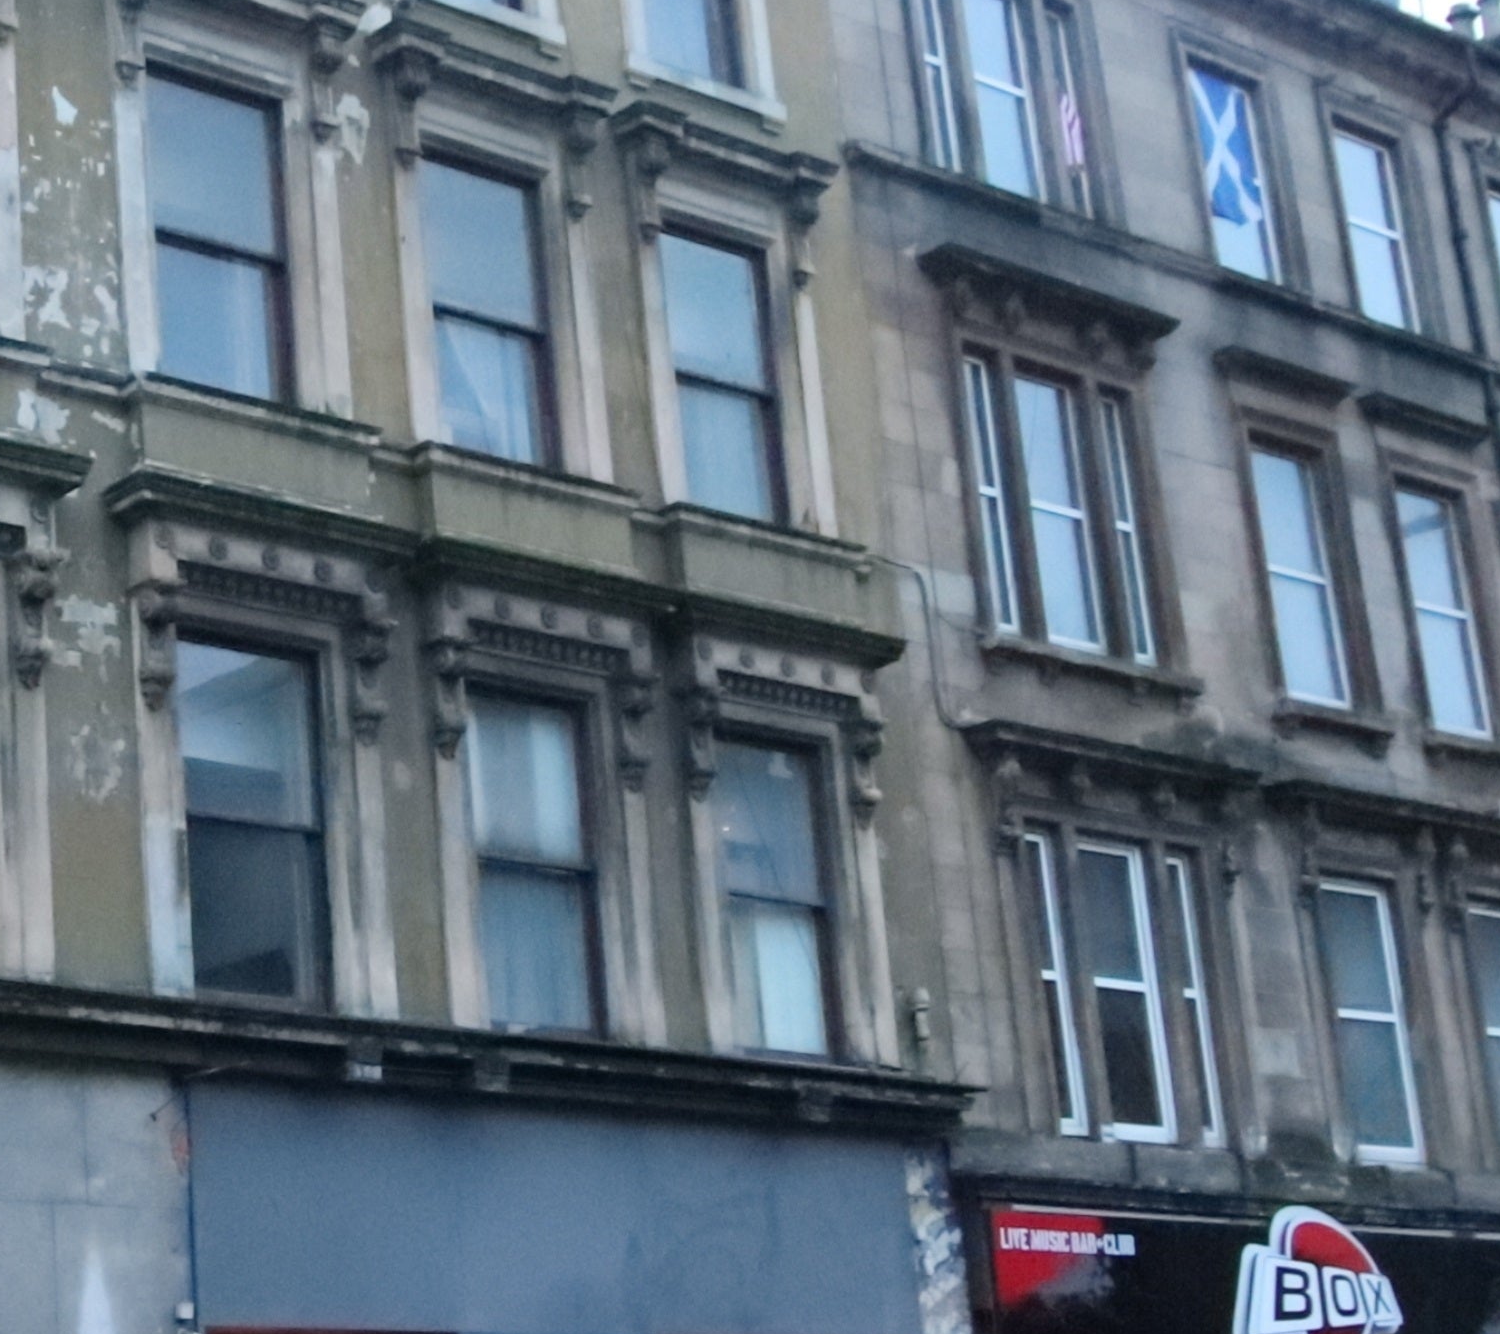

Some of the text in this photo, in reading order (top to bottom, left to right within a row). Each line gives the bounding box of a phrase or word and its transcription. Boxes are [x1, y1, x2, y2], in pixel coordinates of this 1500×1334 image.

[999, 1226, 1030, 1251] LIVE
[1030, 1228, 1071, 1253] MUSIC
[1273, 1265, 1394, 1322] BOX
